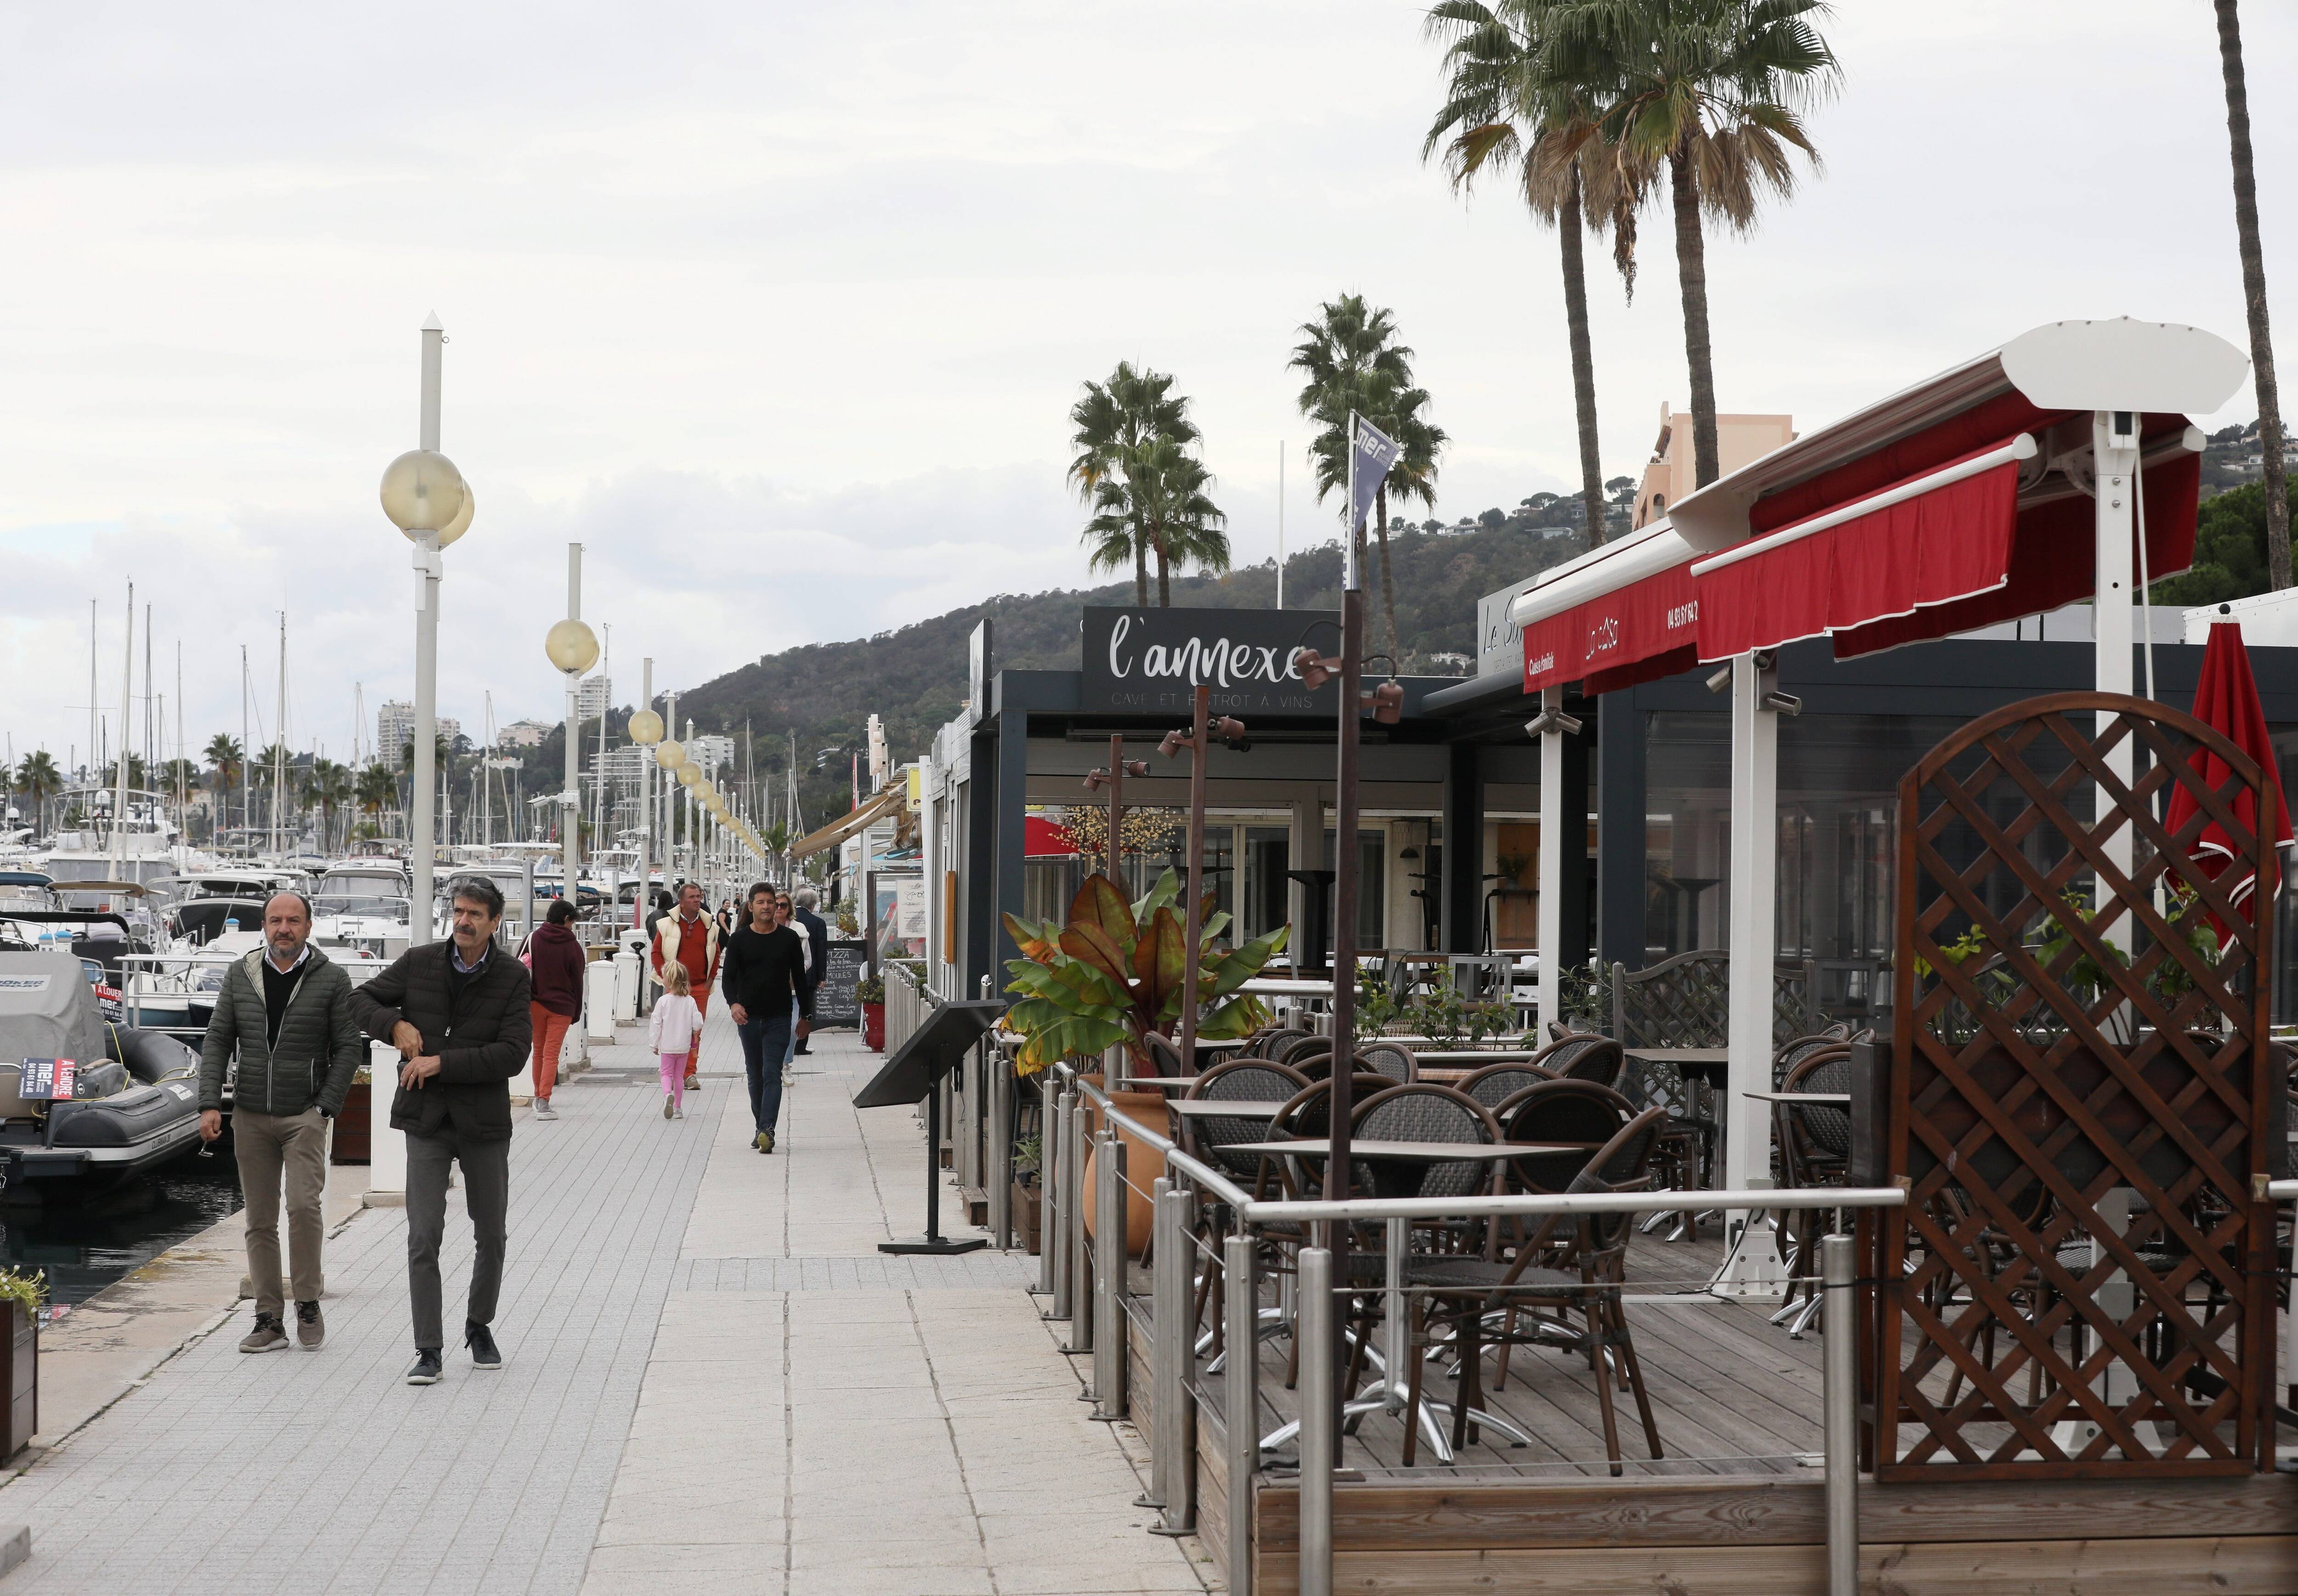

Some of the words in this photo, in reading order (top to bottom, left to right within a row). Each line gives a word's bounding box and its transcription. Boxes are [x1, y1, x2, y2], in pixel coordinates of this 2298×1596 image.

[1358, 426, 1387, 459] mer
[1667, 608, 1674, 630] 04
[1674, 607, 1681, 628] 93
[1681, 604, 1688, 625] 61
[1688, 601, 1694, 623] 64
[1694, 600, 1698, 621] 2
[1484, 604, 1497, 654] Le
[1111, 692, 1148, 705] CAVE
[1160, 693, 1176, 706] ET
[1261, 693, 1270, 707] À
[1280, 695, 1313, 708] VINS
[100, 998, 117, 1010] mer
[103, 987, 122, 999] LOUER
[37, 1063, 53, 1085] mer
[59, 1068, 74, 1096] VENDRE
